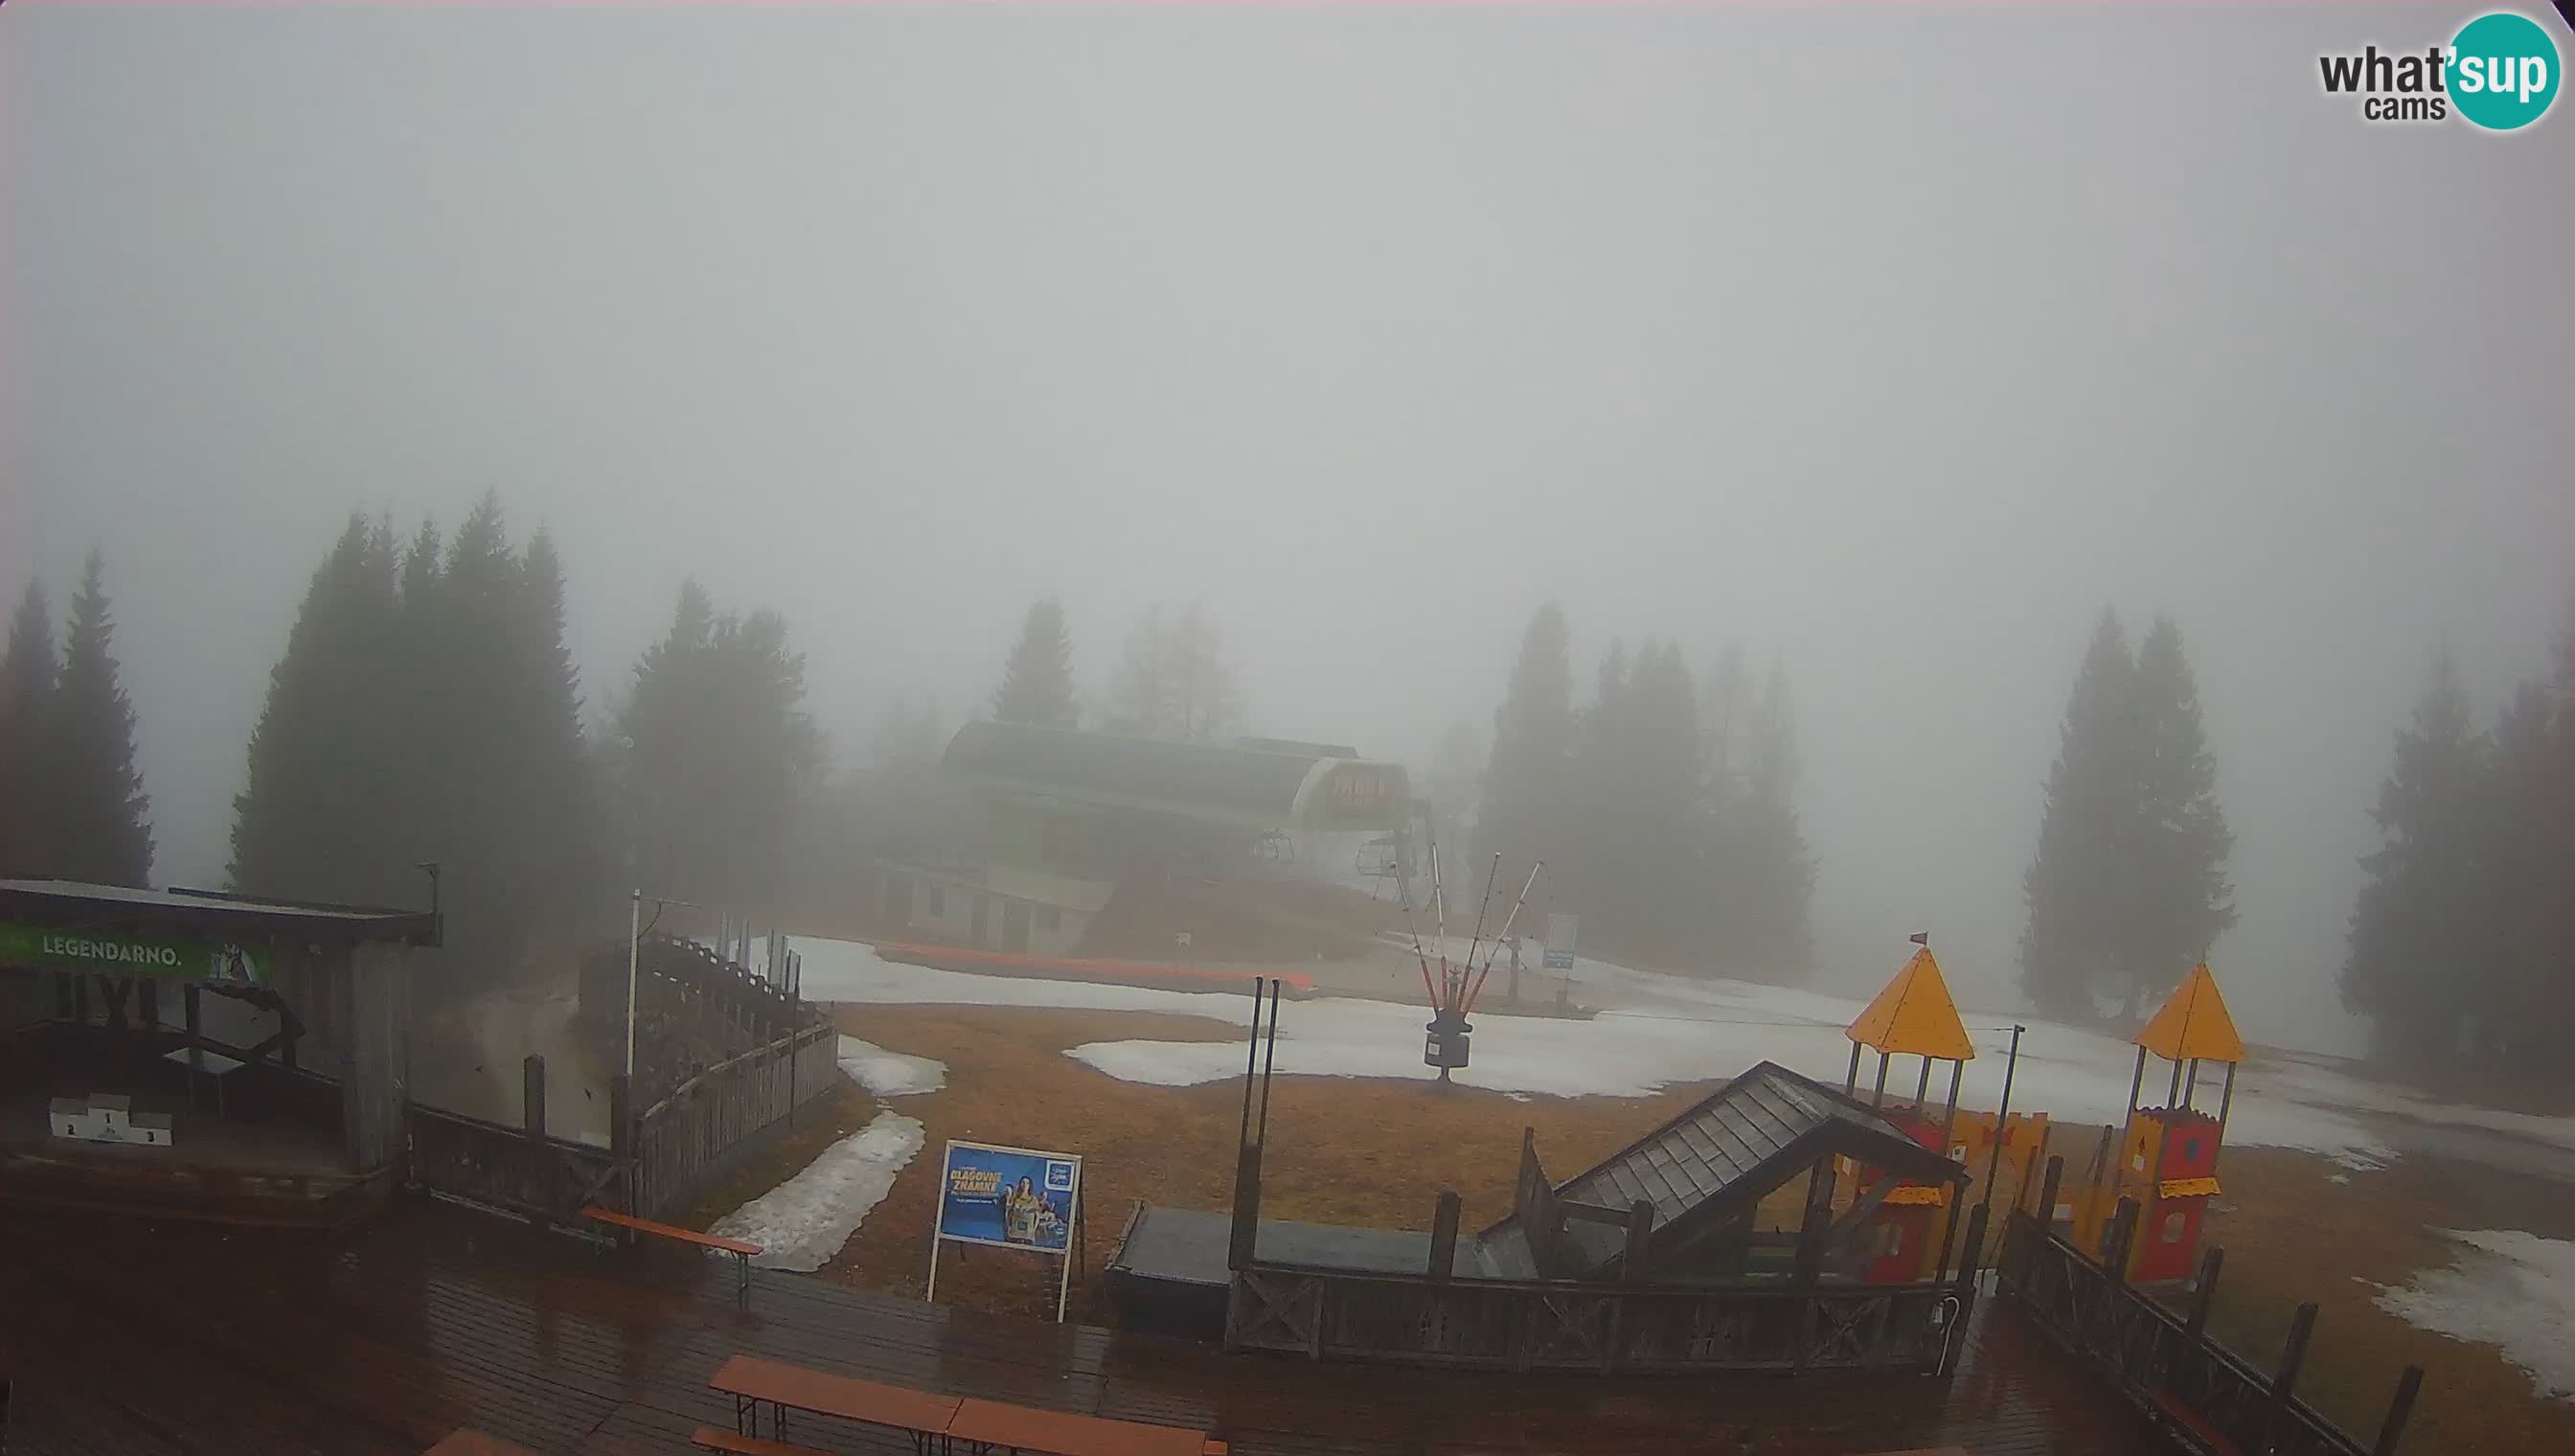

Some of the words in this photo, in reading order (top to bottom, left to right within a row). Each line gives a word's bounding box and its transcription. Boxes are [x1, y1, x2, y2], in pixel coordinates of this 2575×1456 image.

[42, 935, 182, 967] LEGENDARNO.
[67, 1124, 76, 1135] 2
[147, 1131, 155, 1143] 3
